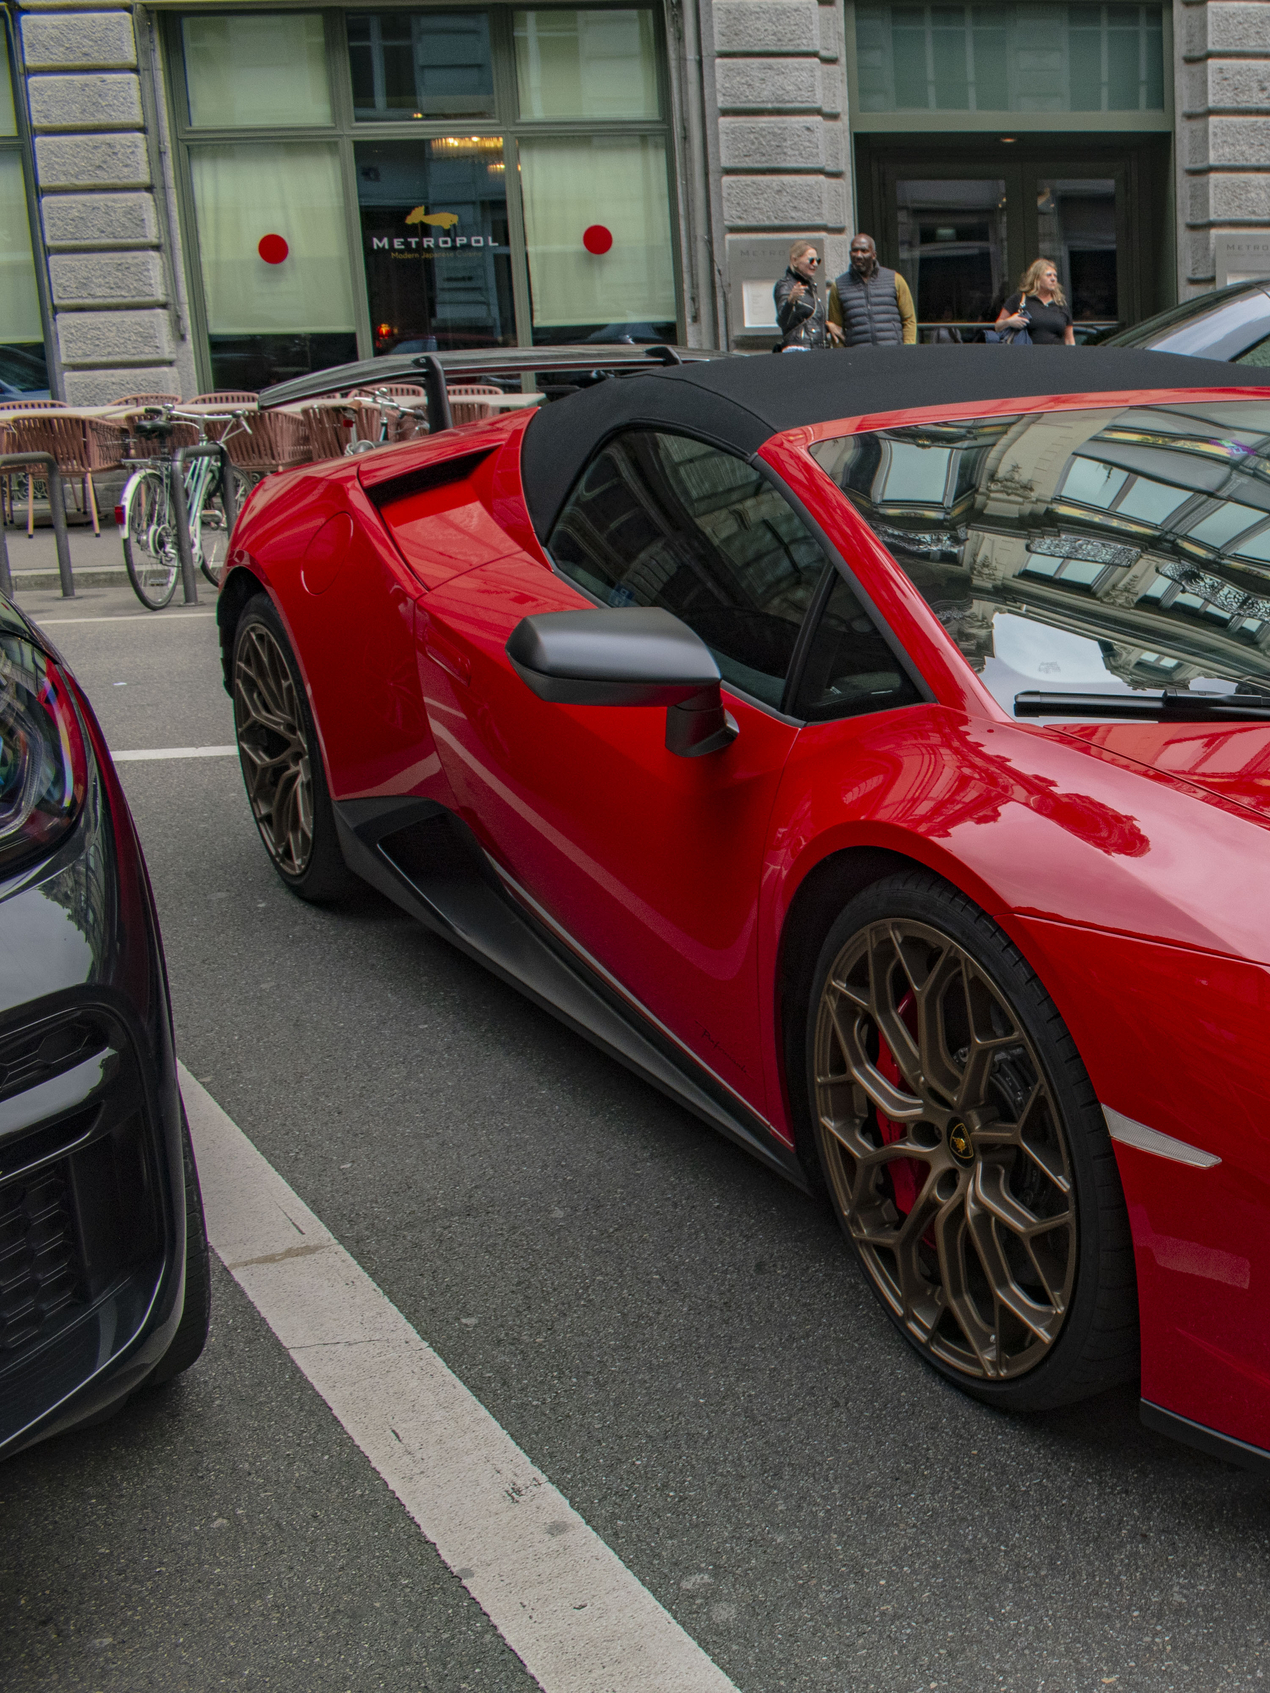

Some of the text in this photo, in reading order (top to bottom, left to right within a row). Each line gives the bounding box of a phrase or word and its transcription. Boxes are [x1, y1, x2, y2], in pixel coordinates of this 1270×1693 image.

[372, 236, 499, 250] METROPOL
[390, 251, 420, 260] Modern
[740, 249, 787, 258] METRO
